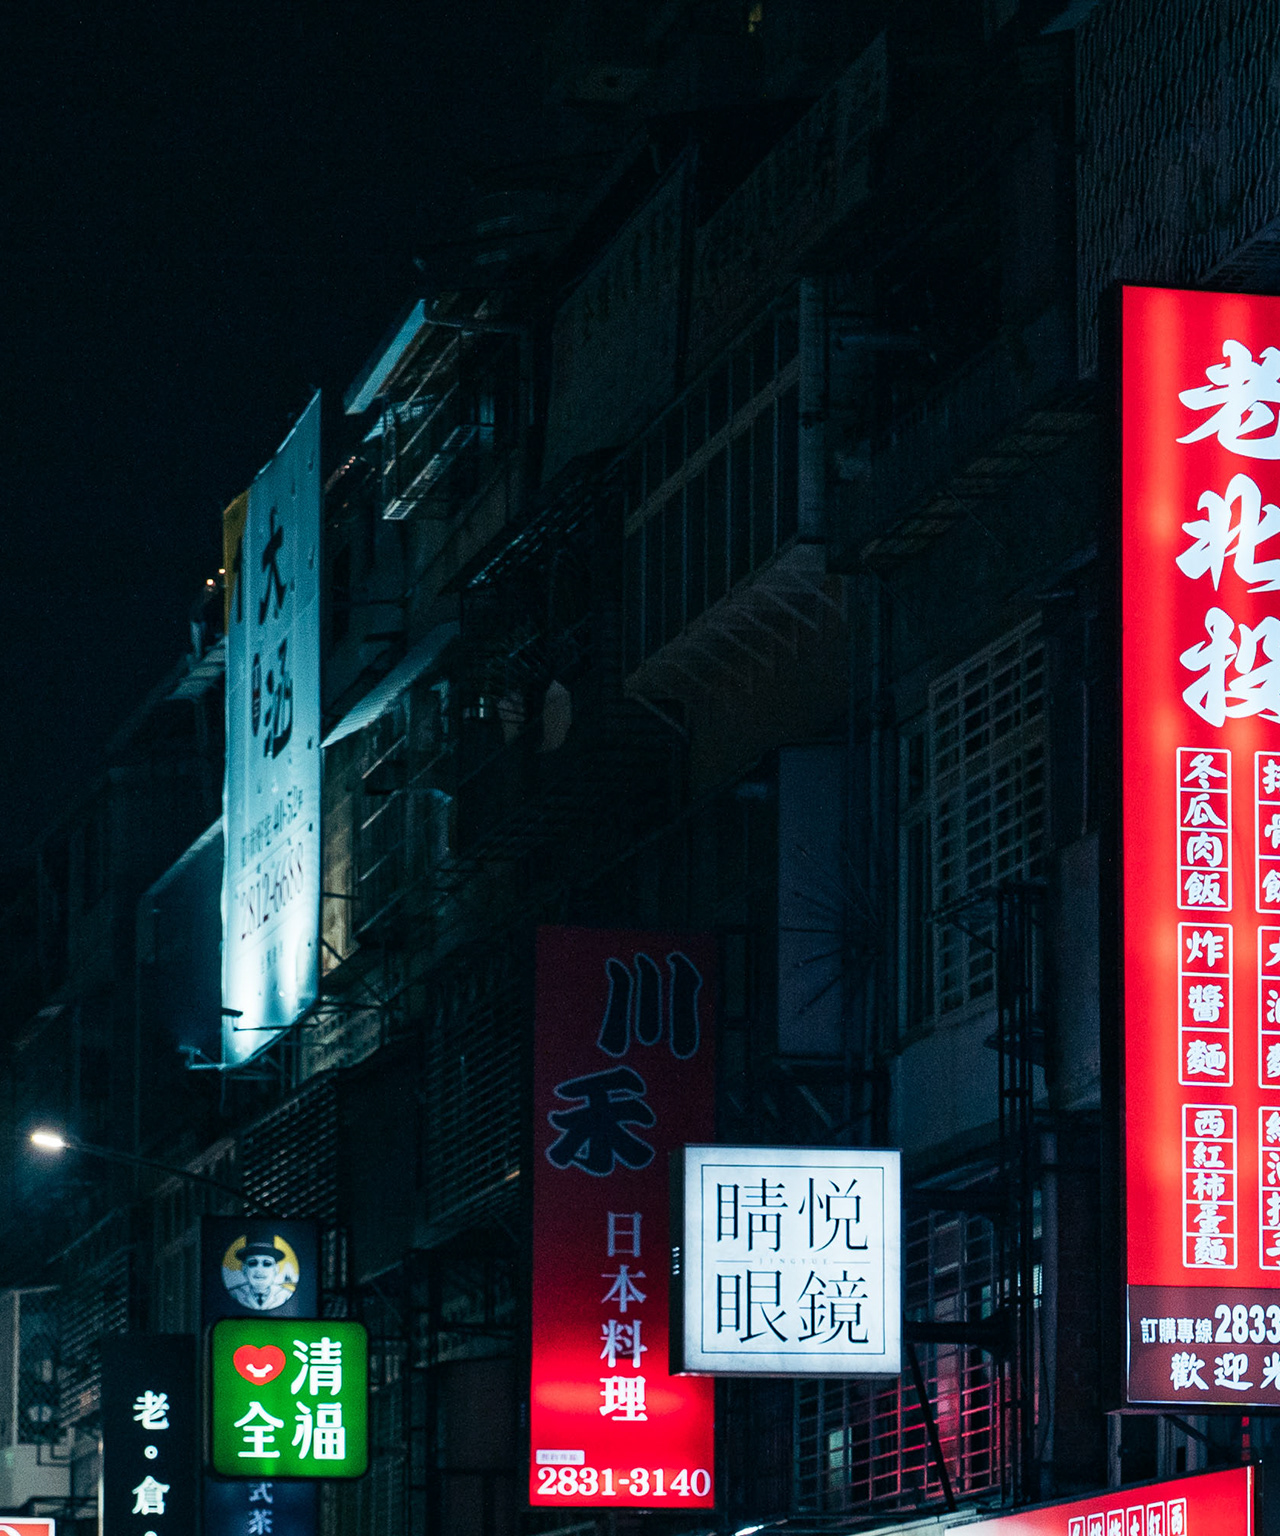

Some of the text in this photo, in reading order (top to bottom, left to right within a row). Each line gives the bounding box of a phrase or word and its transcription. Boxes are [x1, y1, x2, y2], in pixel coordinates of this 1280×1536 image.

[1183, 753, 1227, 906] 冬瓜肉飯
[1186, 930, 1227, 1077] 炸醬麵
[1192, 1109, 1228, 1266] 西紅柿蛋麵
[599, 1211, 648, 1421] 日本料理
[717, 1270, 870, 1344] 眼鏡
[1140, 1317, 1213, 1344] 訂購專線
[537, 1466, 711, 1497] 2831-3140
